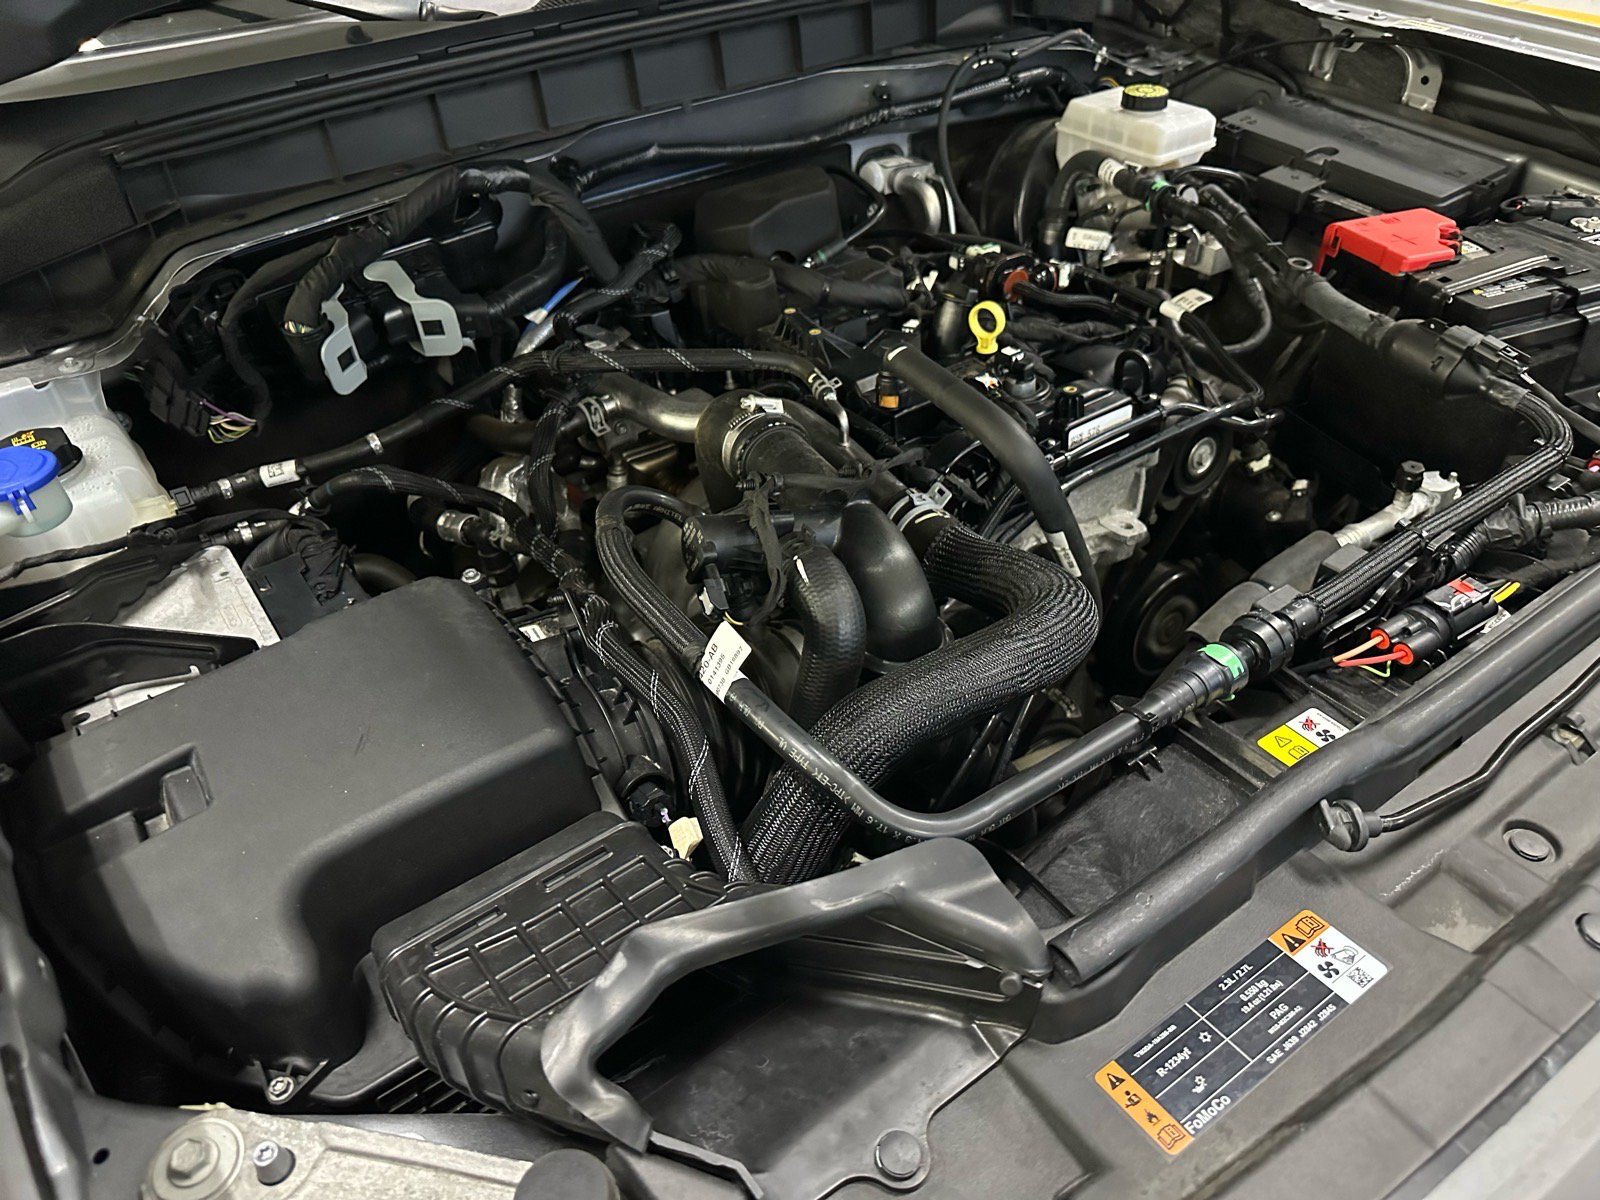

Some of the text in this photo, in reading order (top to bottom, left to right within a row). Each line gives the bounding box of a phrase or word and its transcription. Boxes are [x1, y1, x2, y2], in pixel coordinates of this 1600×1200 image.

[789, 747, 809, 769] TYPE
[866, 815, 887, 832] 17.6
[1218, 978, 1236, 990] 2.3L
[1235, 963, 1253, 977] 2.7L
[1240, 979, 1269, 1000] 0.550 kg
[1269, 1003, 1288, 1019] PAG
[1156, 1046, 1192, 1077] R-1234yf
[1266, 1048, 1284, 1063] SAE
[1282, 1036, 1299, 1050] J639
[1184, 1095, 1231, 1136] FoMoCo
